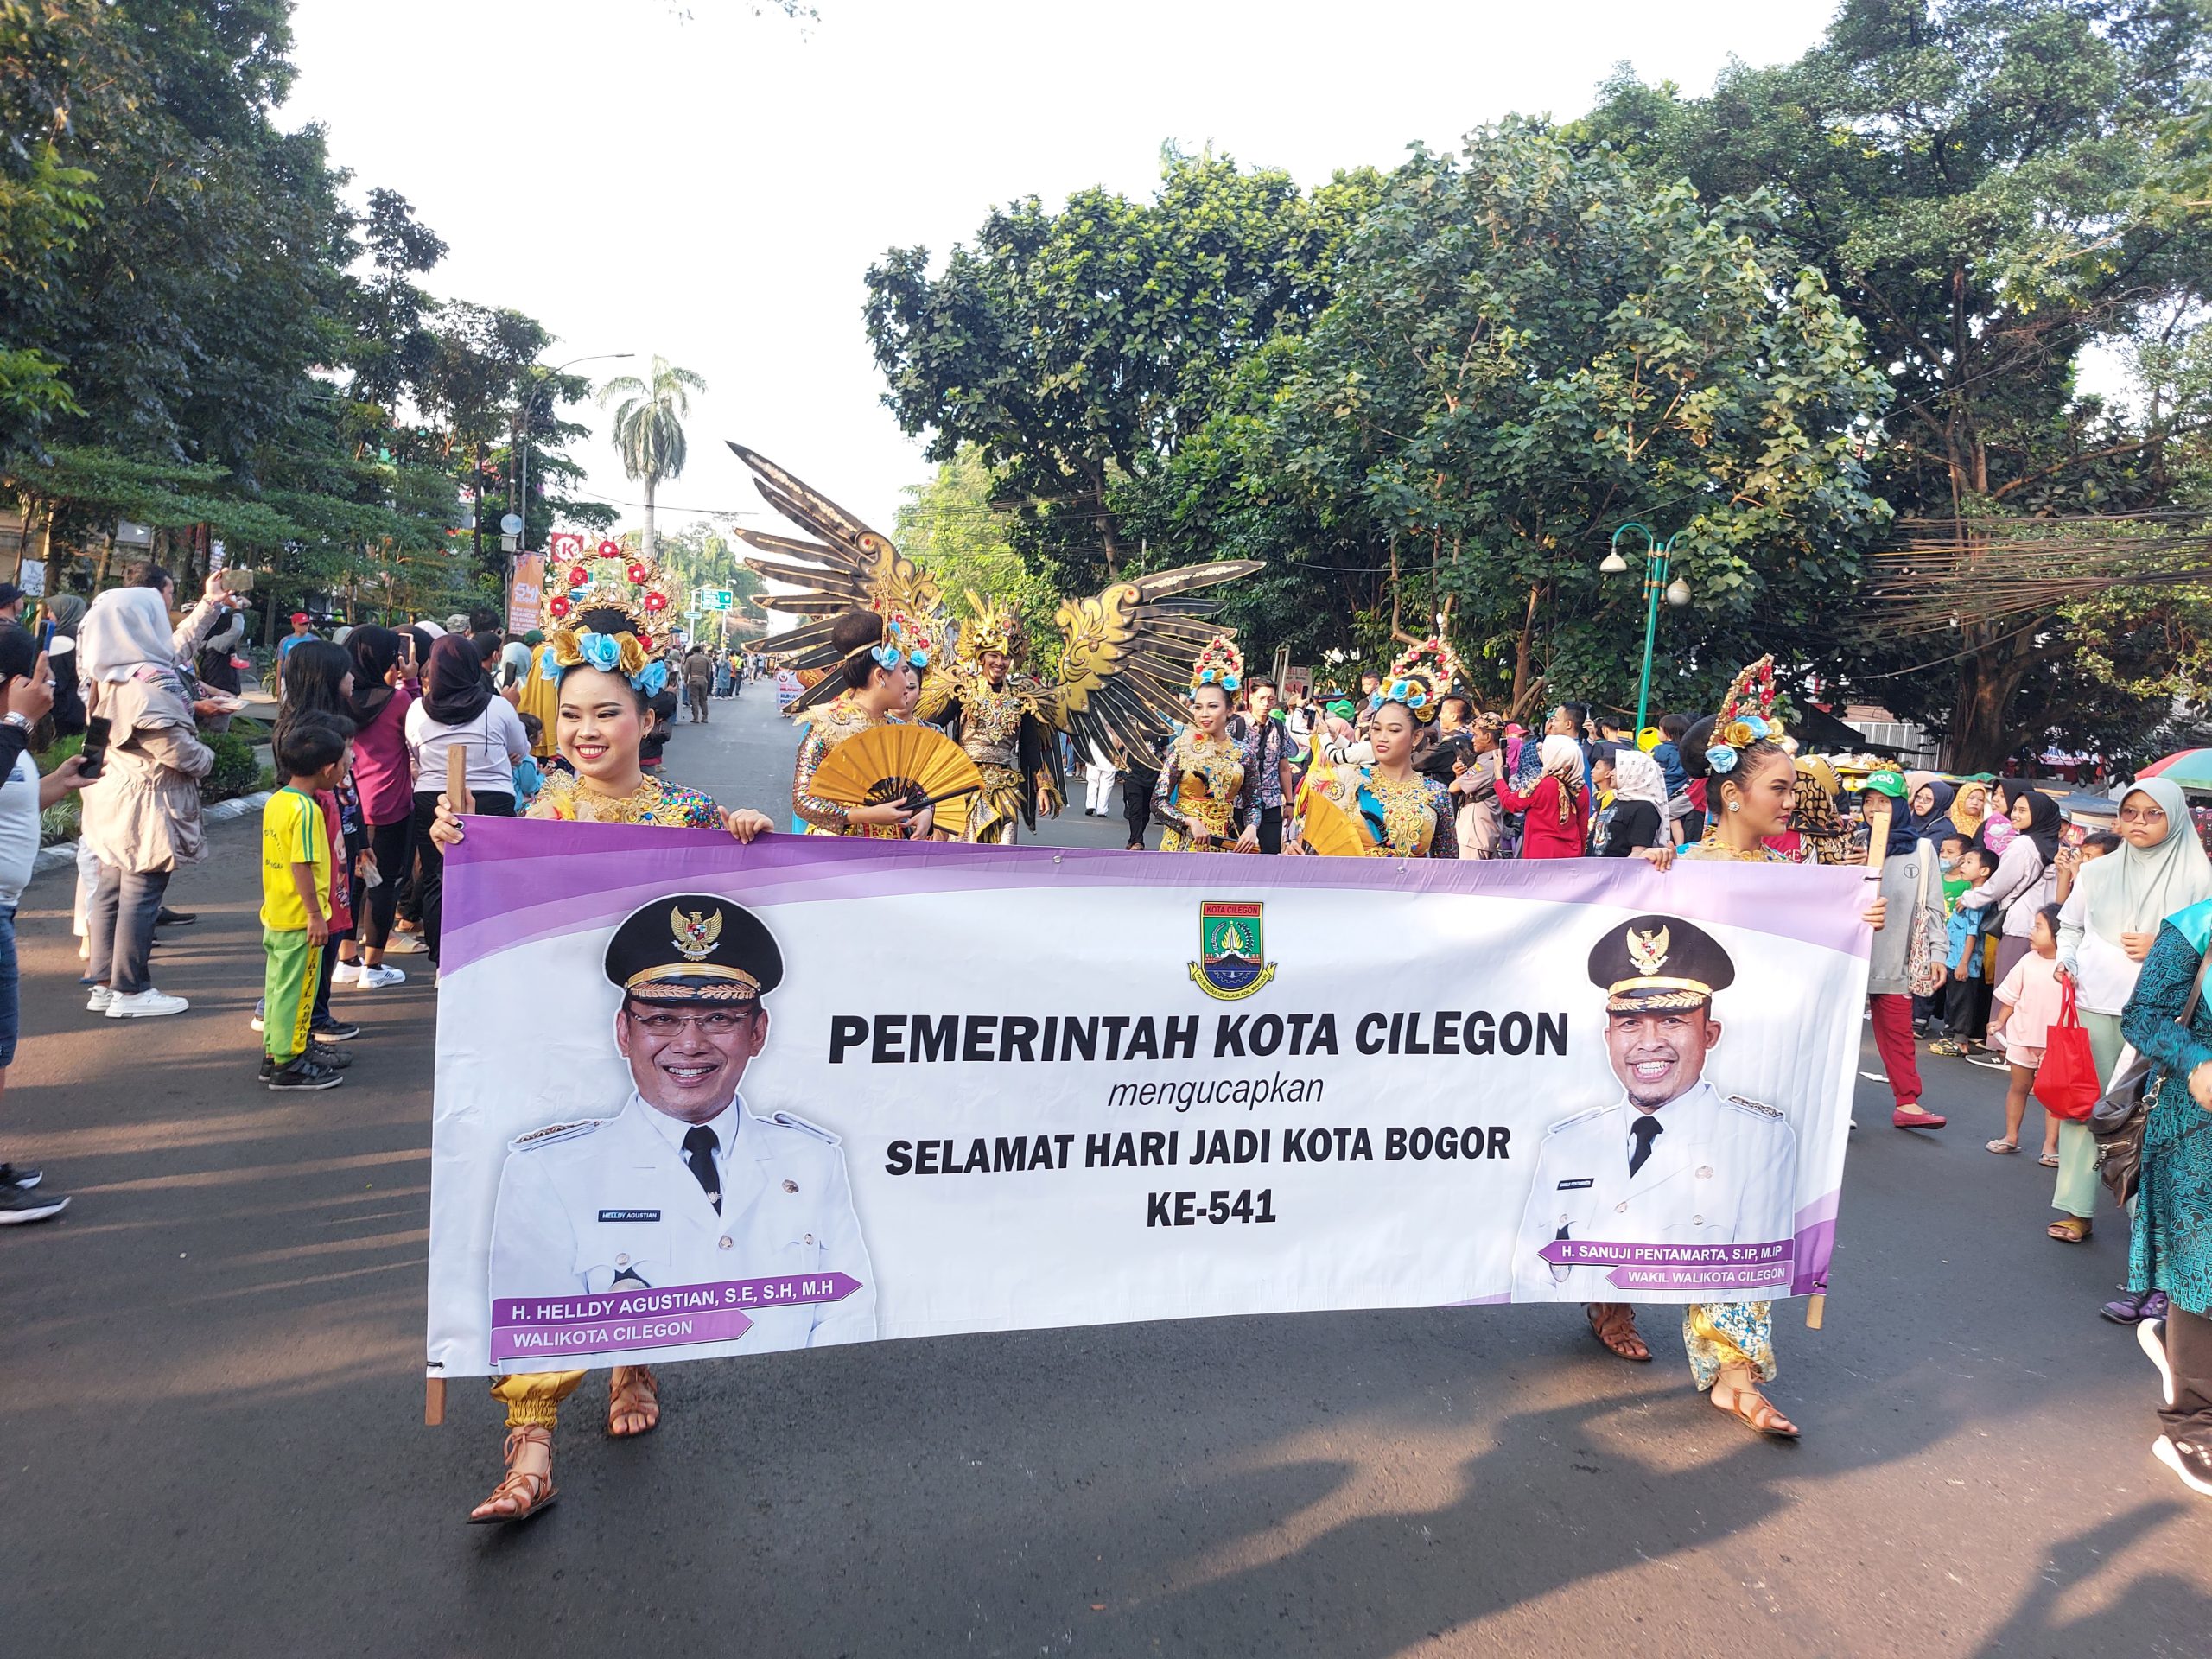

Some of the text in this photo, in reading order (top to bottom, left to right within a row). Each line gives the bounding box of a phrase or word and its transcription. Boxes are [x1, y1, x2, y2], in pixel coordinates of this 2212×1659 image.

[1867, 773, 1895, 785] Grab
[1227, 906, 1258, 914] CILEGON
[829, 1010, 1568, 1065] PEMERINTAH KOTA CILEGON
[1108, 1071, 1324, 1113] mengucapkan
[884, 1126, 1511, 1176] SELAMAT HARI JADI KOTA BOGOR
[1147, 1188, 1277, 1228] KE-541
[1561, 1245, 1575, 1258] H.
[1578, 1246, 1631, 1260] SANUJI
[1634, 1247, 1729, 1262] PENTAMARTA,
[1760, 1245, 1783, 1259] M.IP
[1628, 1267, 1786, 1284] WAKIL WALIKOTA CILEGON
[512, 1279, 834, 1320] H. HELLDY AGUSTIAN, S.E, S.H, M.H
[512, 1319, 693, 1349] WALIKOTA CILEGON
